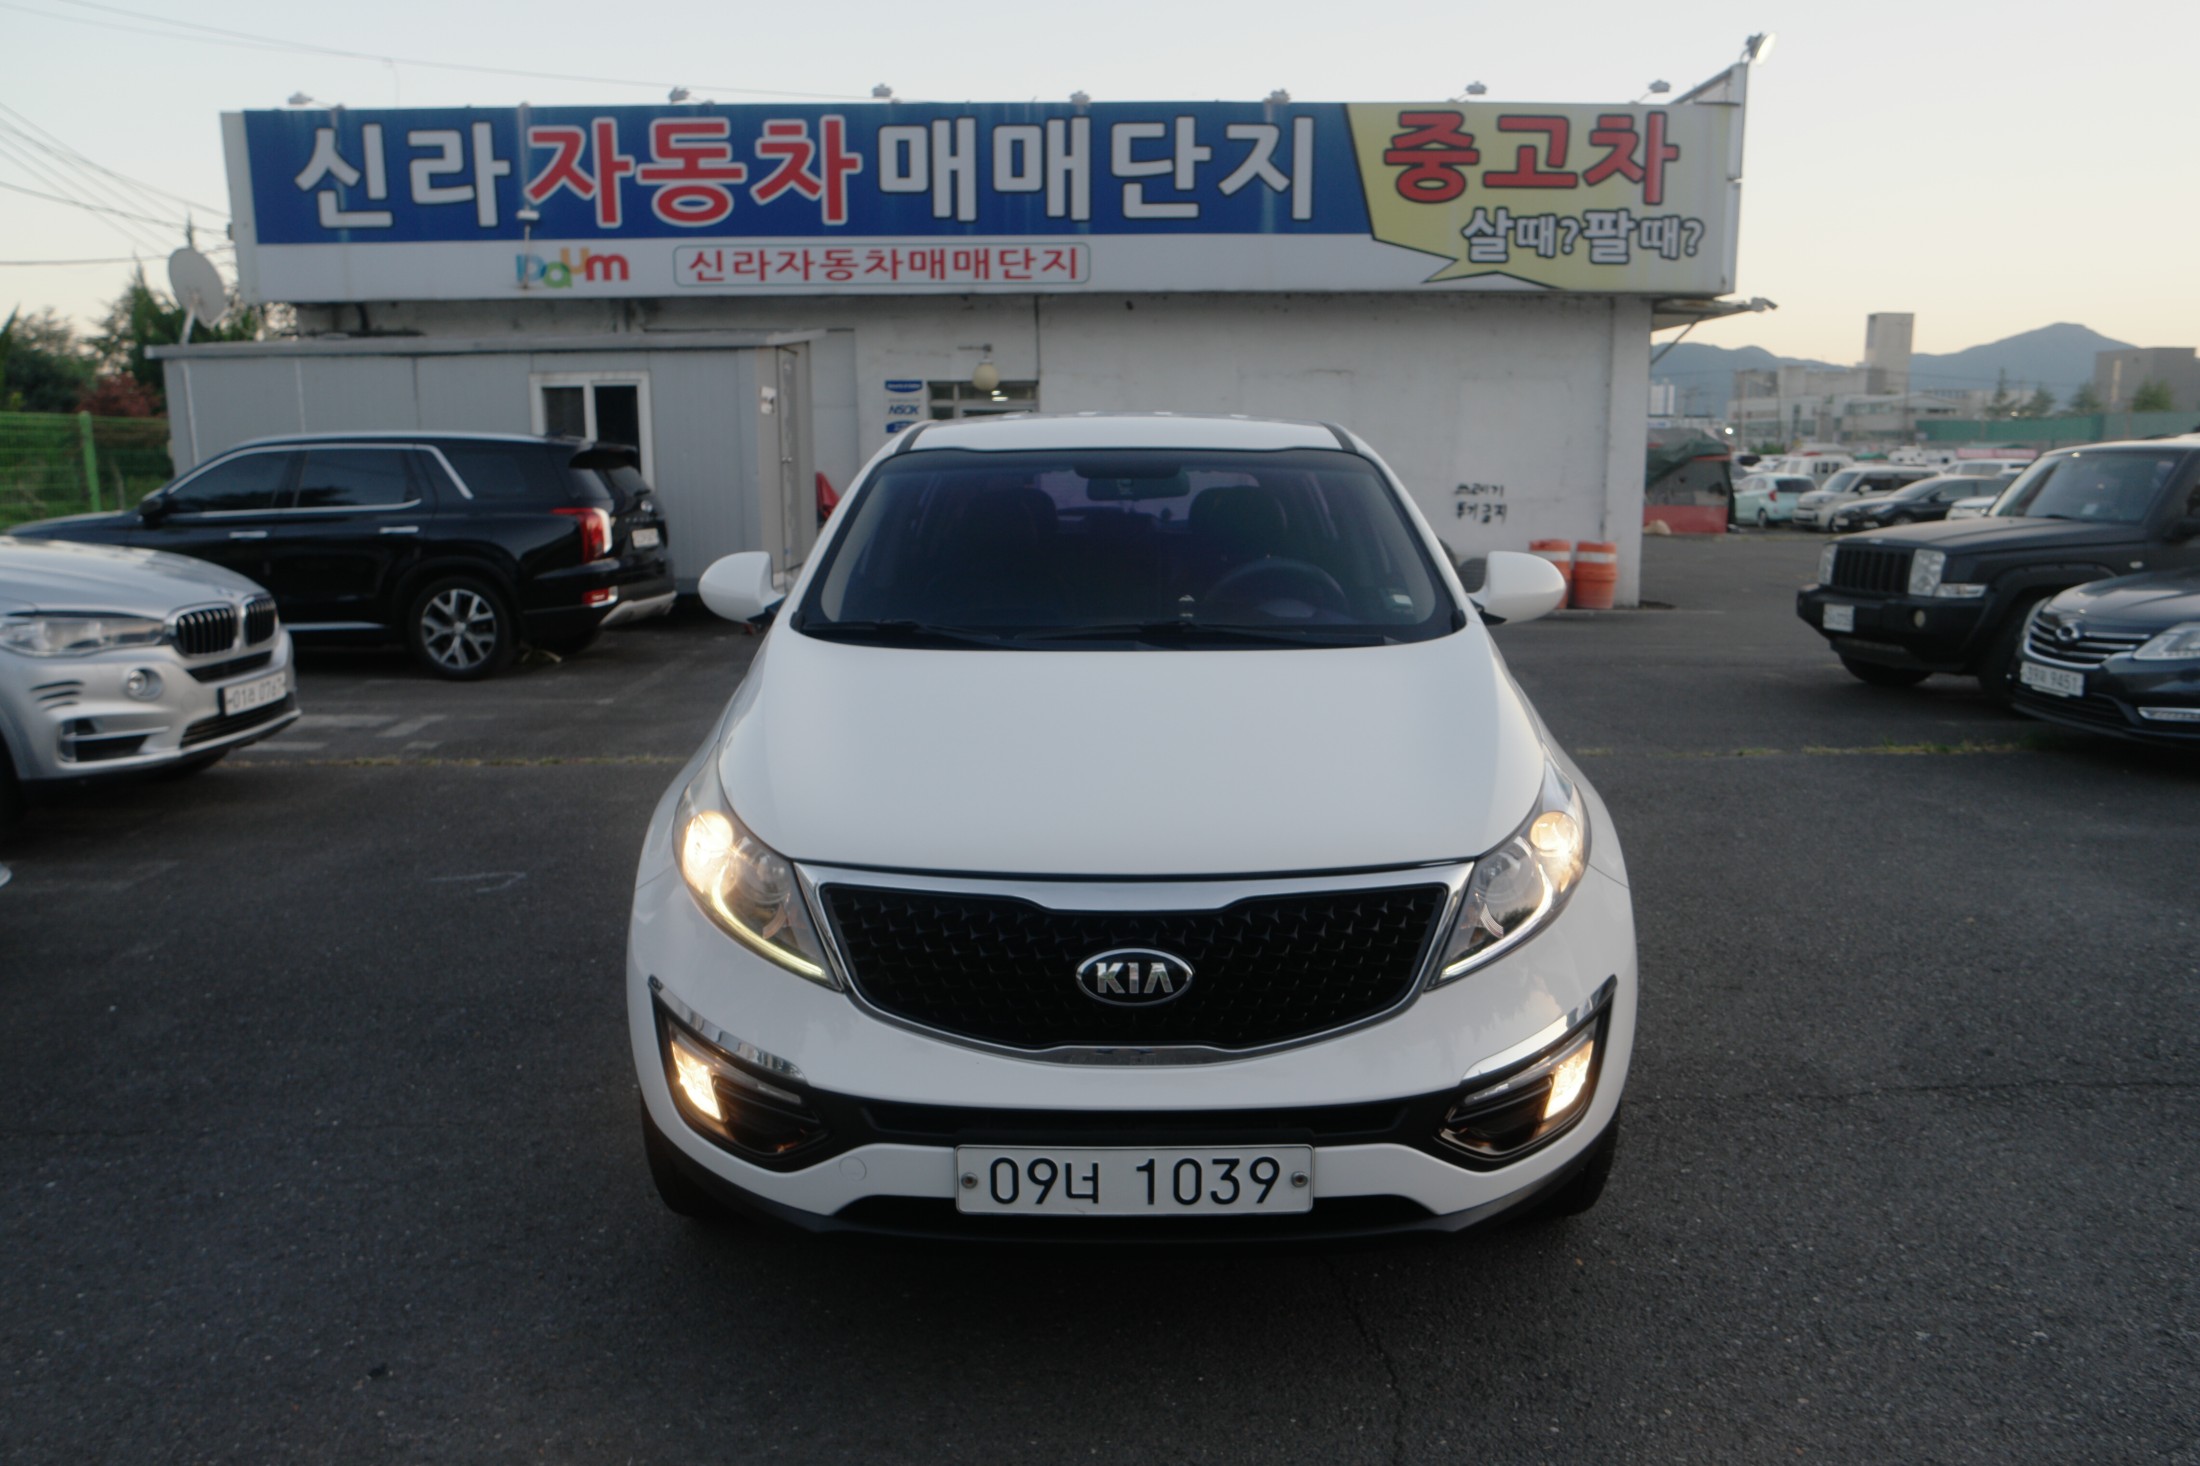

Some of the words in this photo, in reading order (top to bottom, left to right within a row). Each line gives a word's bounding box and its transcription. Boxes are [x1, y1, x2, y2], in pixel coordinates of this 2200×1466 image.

[1384, 111, 1680, 205] 중고차
[688, 247, 1079, 282] 신라자동차매매단지
[1095, 962, 1174, 994] KIA
[989, 1157, 1099, 1205] 09너
[1136, 1156, 1281, 1206] 1039
